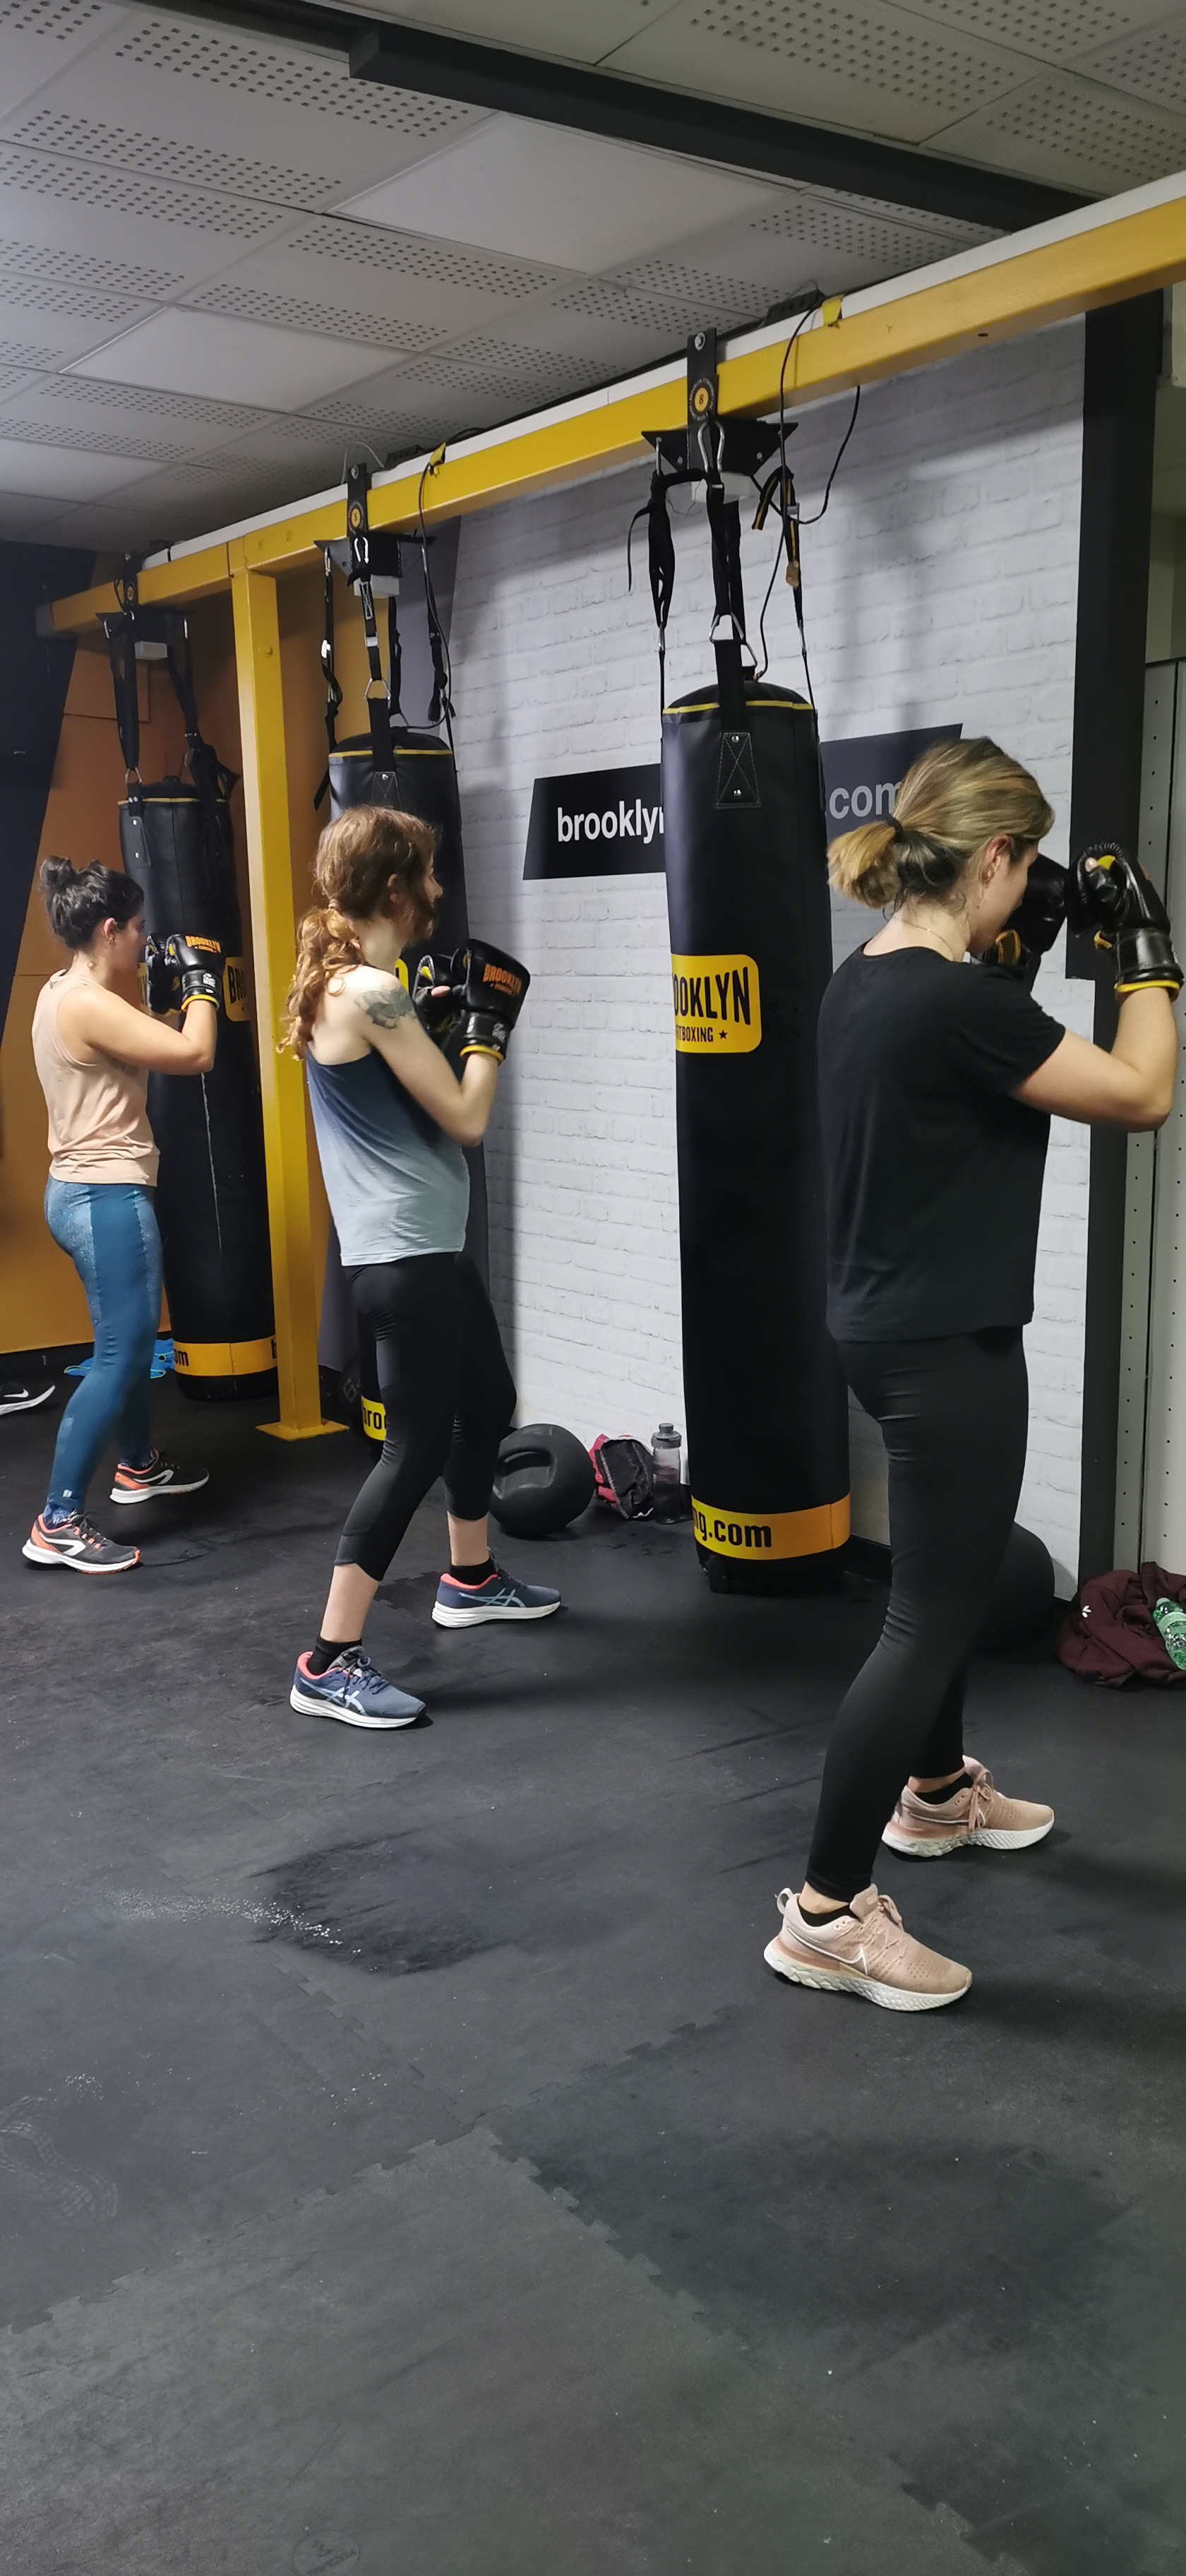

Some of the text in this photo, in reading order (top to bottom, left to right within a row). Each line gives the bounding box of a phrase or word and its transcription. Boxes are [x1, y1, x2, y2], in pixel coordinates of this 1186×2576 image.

[699, 393, 704, 405] 8
[825, 781, 902, 819] com
[676, 1025, 713, 1042] TBOXING
